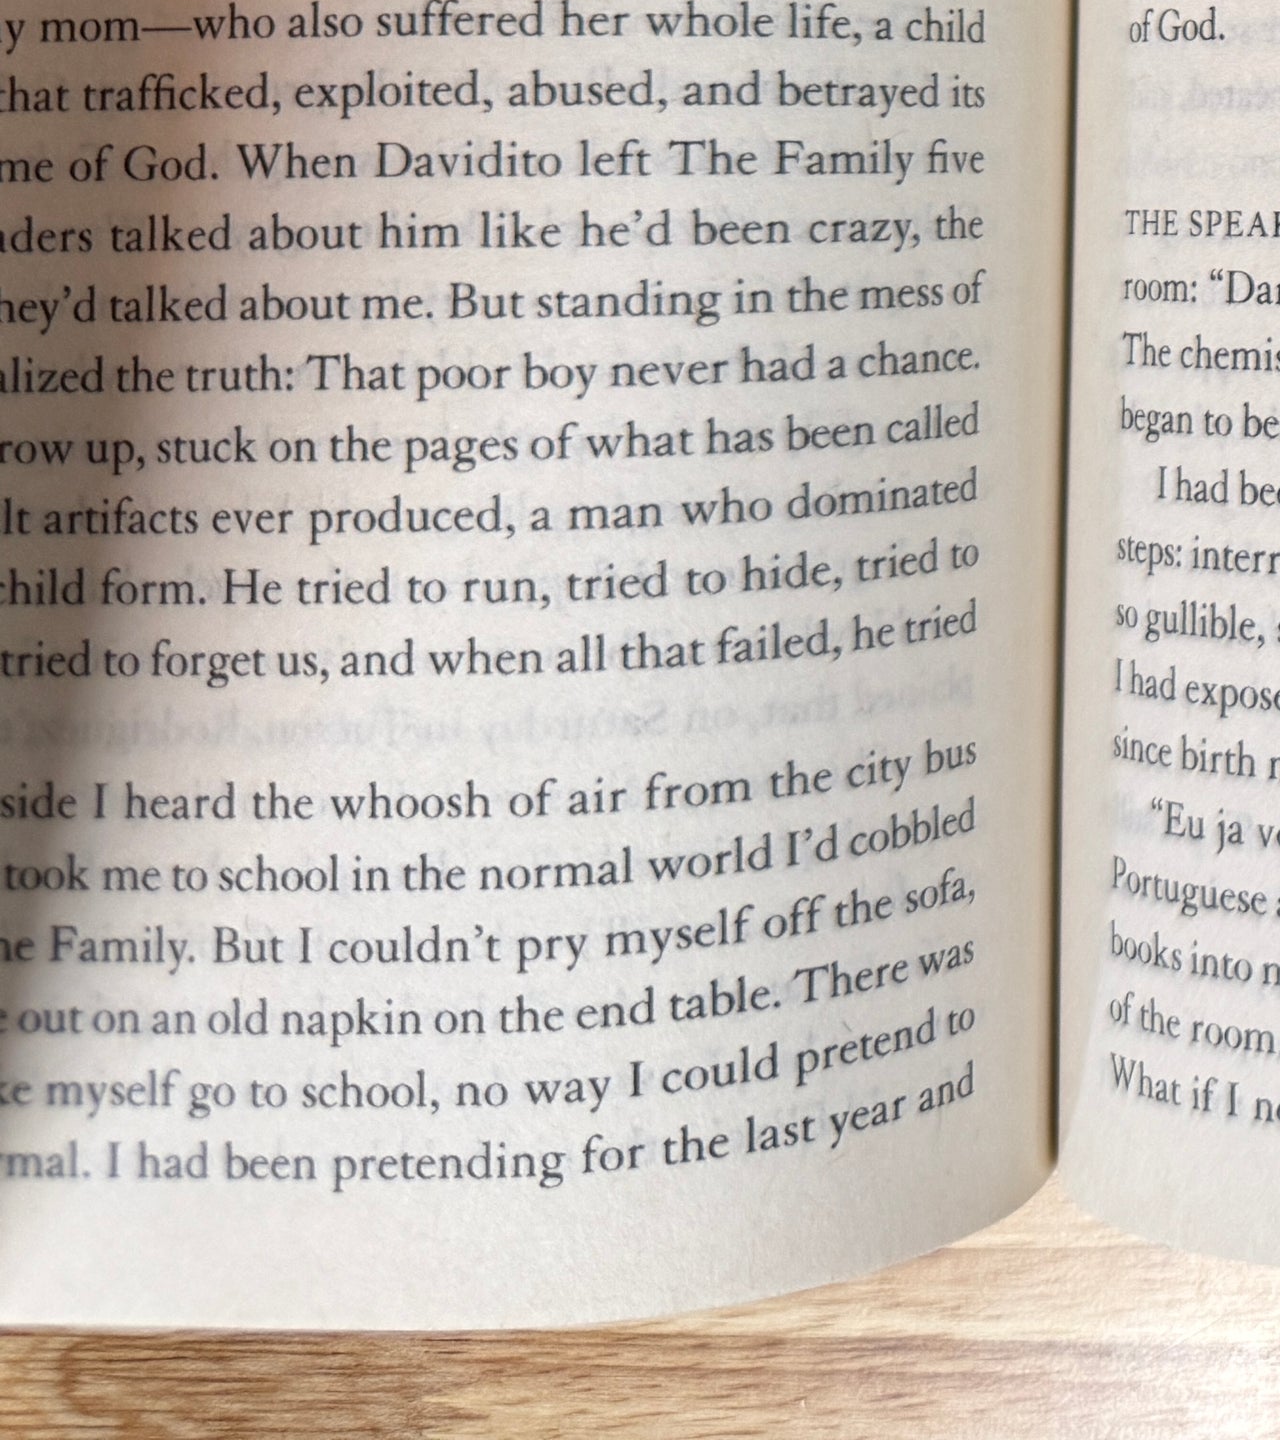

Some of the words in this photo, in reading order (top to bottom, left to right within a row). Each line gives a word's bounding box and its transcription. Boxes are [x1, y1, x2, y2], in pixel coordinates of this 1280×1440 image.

[83, 71, 281, 116] trafficked,
[294, 68, 493, 120] exploited,
[508, 68, 668, 113] abused,
[682, 69, 761, 107] and
[777, 69, 939, 119] betrayed
[952, 83, 985, 109] its
[110, 212, 231, 253] talked
[248, 212, 363, 251] about
[379, 210, 460, 249] him
[480, 210, 561, 249] like
[580, 208, 672, 248] he’d
[691, 208, 791, 246] been
[808, 219, 921, 253] crazy,
[935, 204, 983, 241] the
[1124, 209, 1178, 236] THE
[1123, 278, 1197, 303] room:
[43, 495, 199, 536] artifacts
[211, 509, 294, 535] ever
[309, 493, 516, 546] produced,
[530, 507, 552, 532] a
[568, 503, 663, 531] man
[681, 486, 773, 525] who
[787, 465, 977, 520] dominated
[94, 782, 105, 819] I
[125, 781, 235, 820] heard
[252, 781, 313, 820] the
[330, 779, 491, 820] whoosh
[509, 777, 558, 818] of
[568, 788, 627, 816] air
[645, 771, 752, 811] from
[769, 759, 833, 799] the
[846, 756, 911, 793] city
[925, 738, 977, 775] bus
[1111, 1053, 1181, 1106] What
[1192, 1077, 1218, 1112] if
[1227, 1082, 1238, 1117] I
